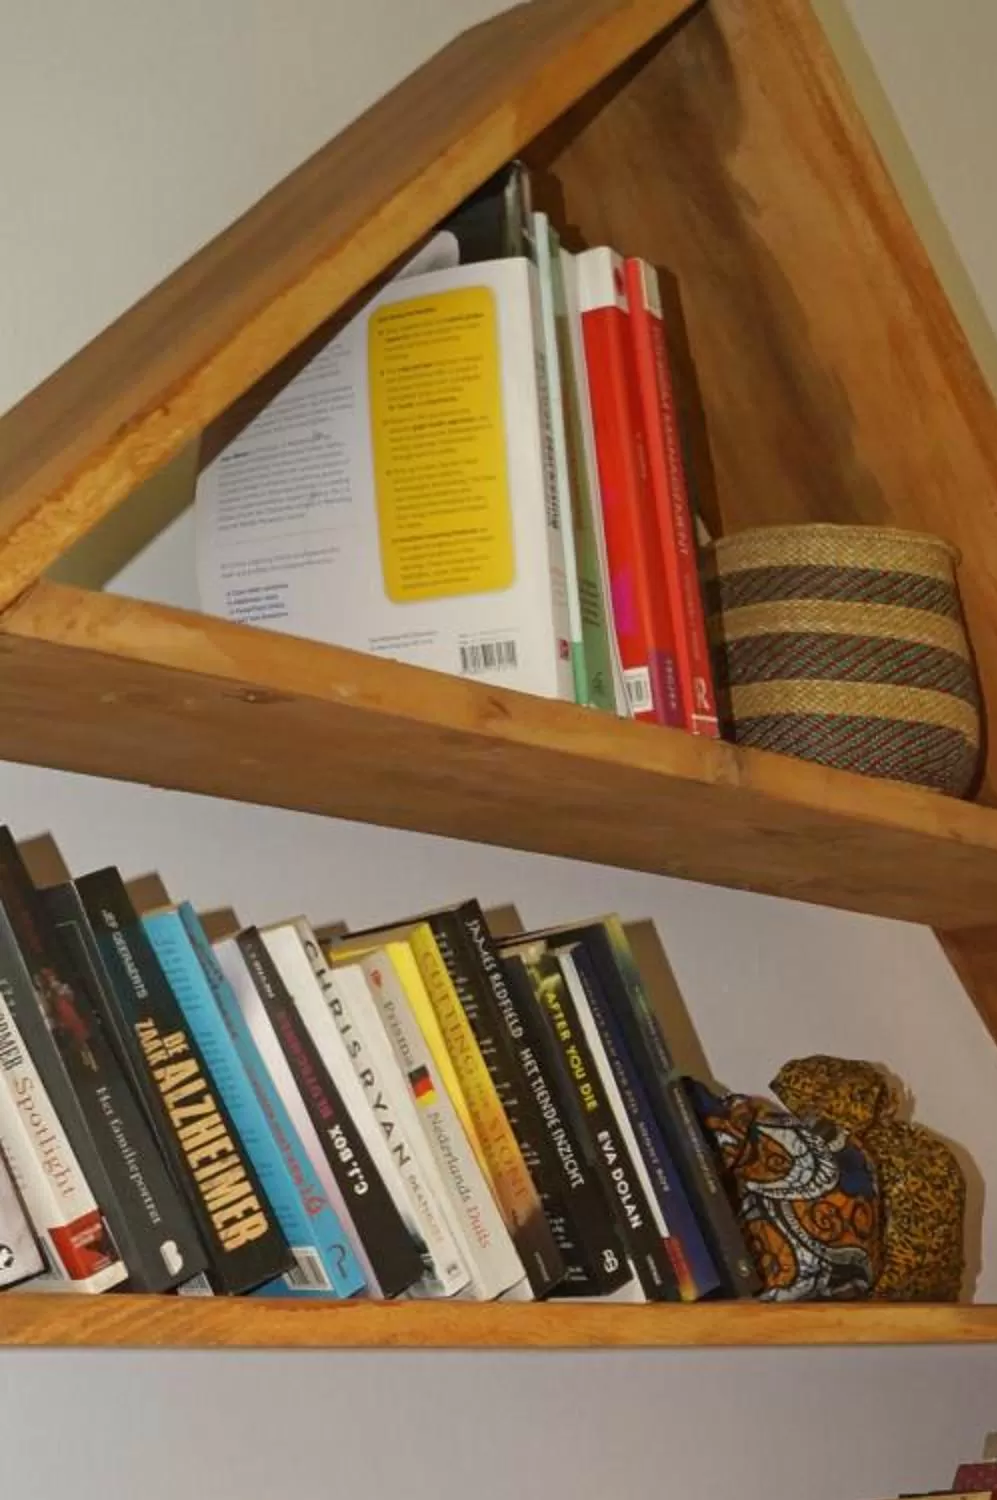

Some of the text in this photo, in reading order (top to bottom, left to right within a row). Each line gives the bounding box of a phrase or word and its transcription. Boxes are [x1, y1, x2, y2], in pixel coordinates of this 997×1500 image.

[134, 1019, 171, 1070] ZAAK
[165, 1031, 189, 1060] DE
[304, 939, 410, 1167] CHRIS RYAN
[464, 916, 497, 972] JAMES
[487, 971, 525, 1041] REDFIELD
[517, 1047, 539, 1076] HET
[529, 1076, 560, 1130] TIENDE
[549, 1127, 585, 1189] INZICHT
[544, 990, 598, 1112] AFTER YOU DIE
[15, 1077, 77, 1197] Spotlight
[96, 1086, 162, 1224] Het familieportret
[155, 1061, 269, 1251] ALZHEIMER
[329, 1124, 354, 1162] BOX
[428, 1112, 469, 1205] Nederlands
[598, 1131, 620, 1165] EVA
[611, 1167, 644, 1230] DOLAN
